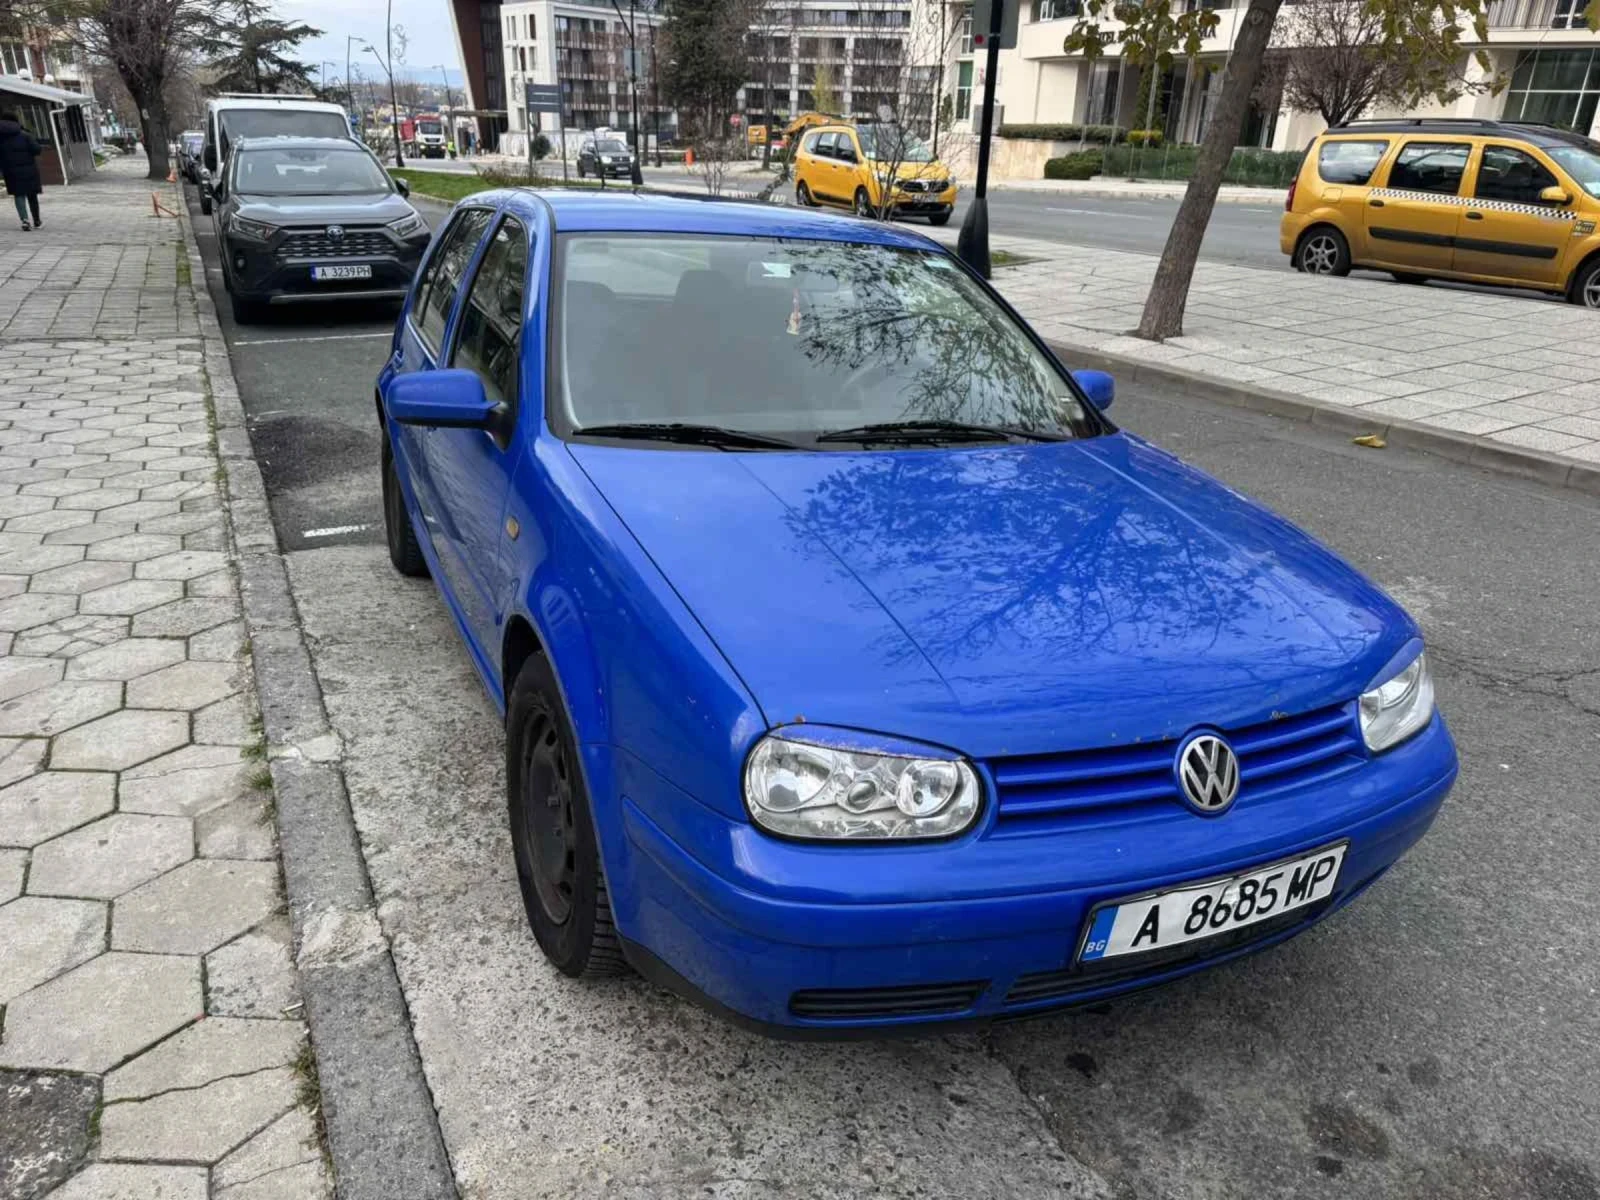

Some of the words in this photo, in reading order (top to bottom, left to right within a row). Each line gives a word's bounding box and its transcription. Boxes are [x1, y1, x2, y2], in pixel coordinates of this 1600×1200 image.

[1180, 735, 1238, 810] VW
[1130, 904, 1160, 947] A
[1183, 872, 1284, 936] 8685
[1284, 855, 1336, 907] MP
[1085, 940, 1106, 953] BG
